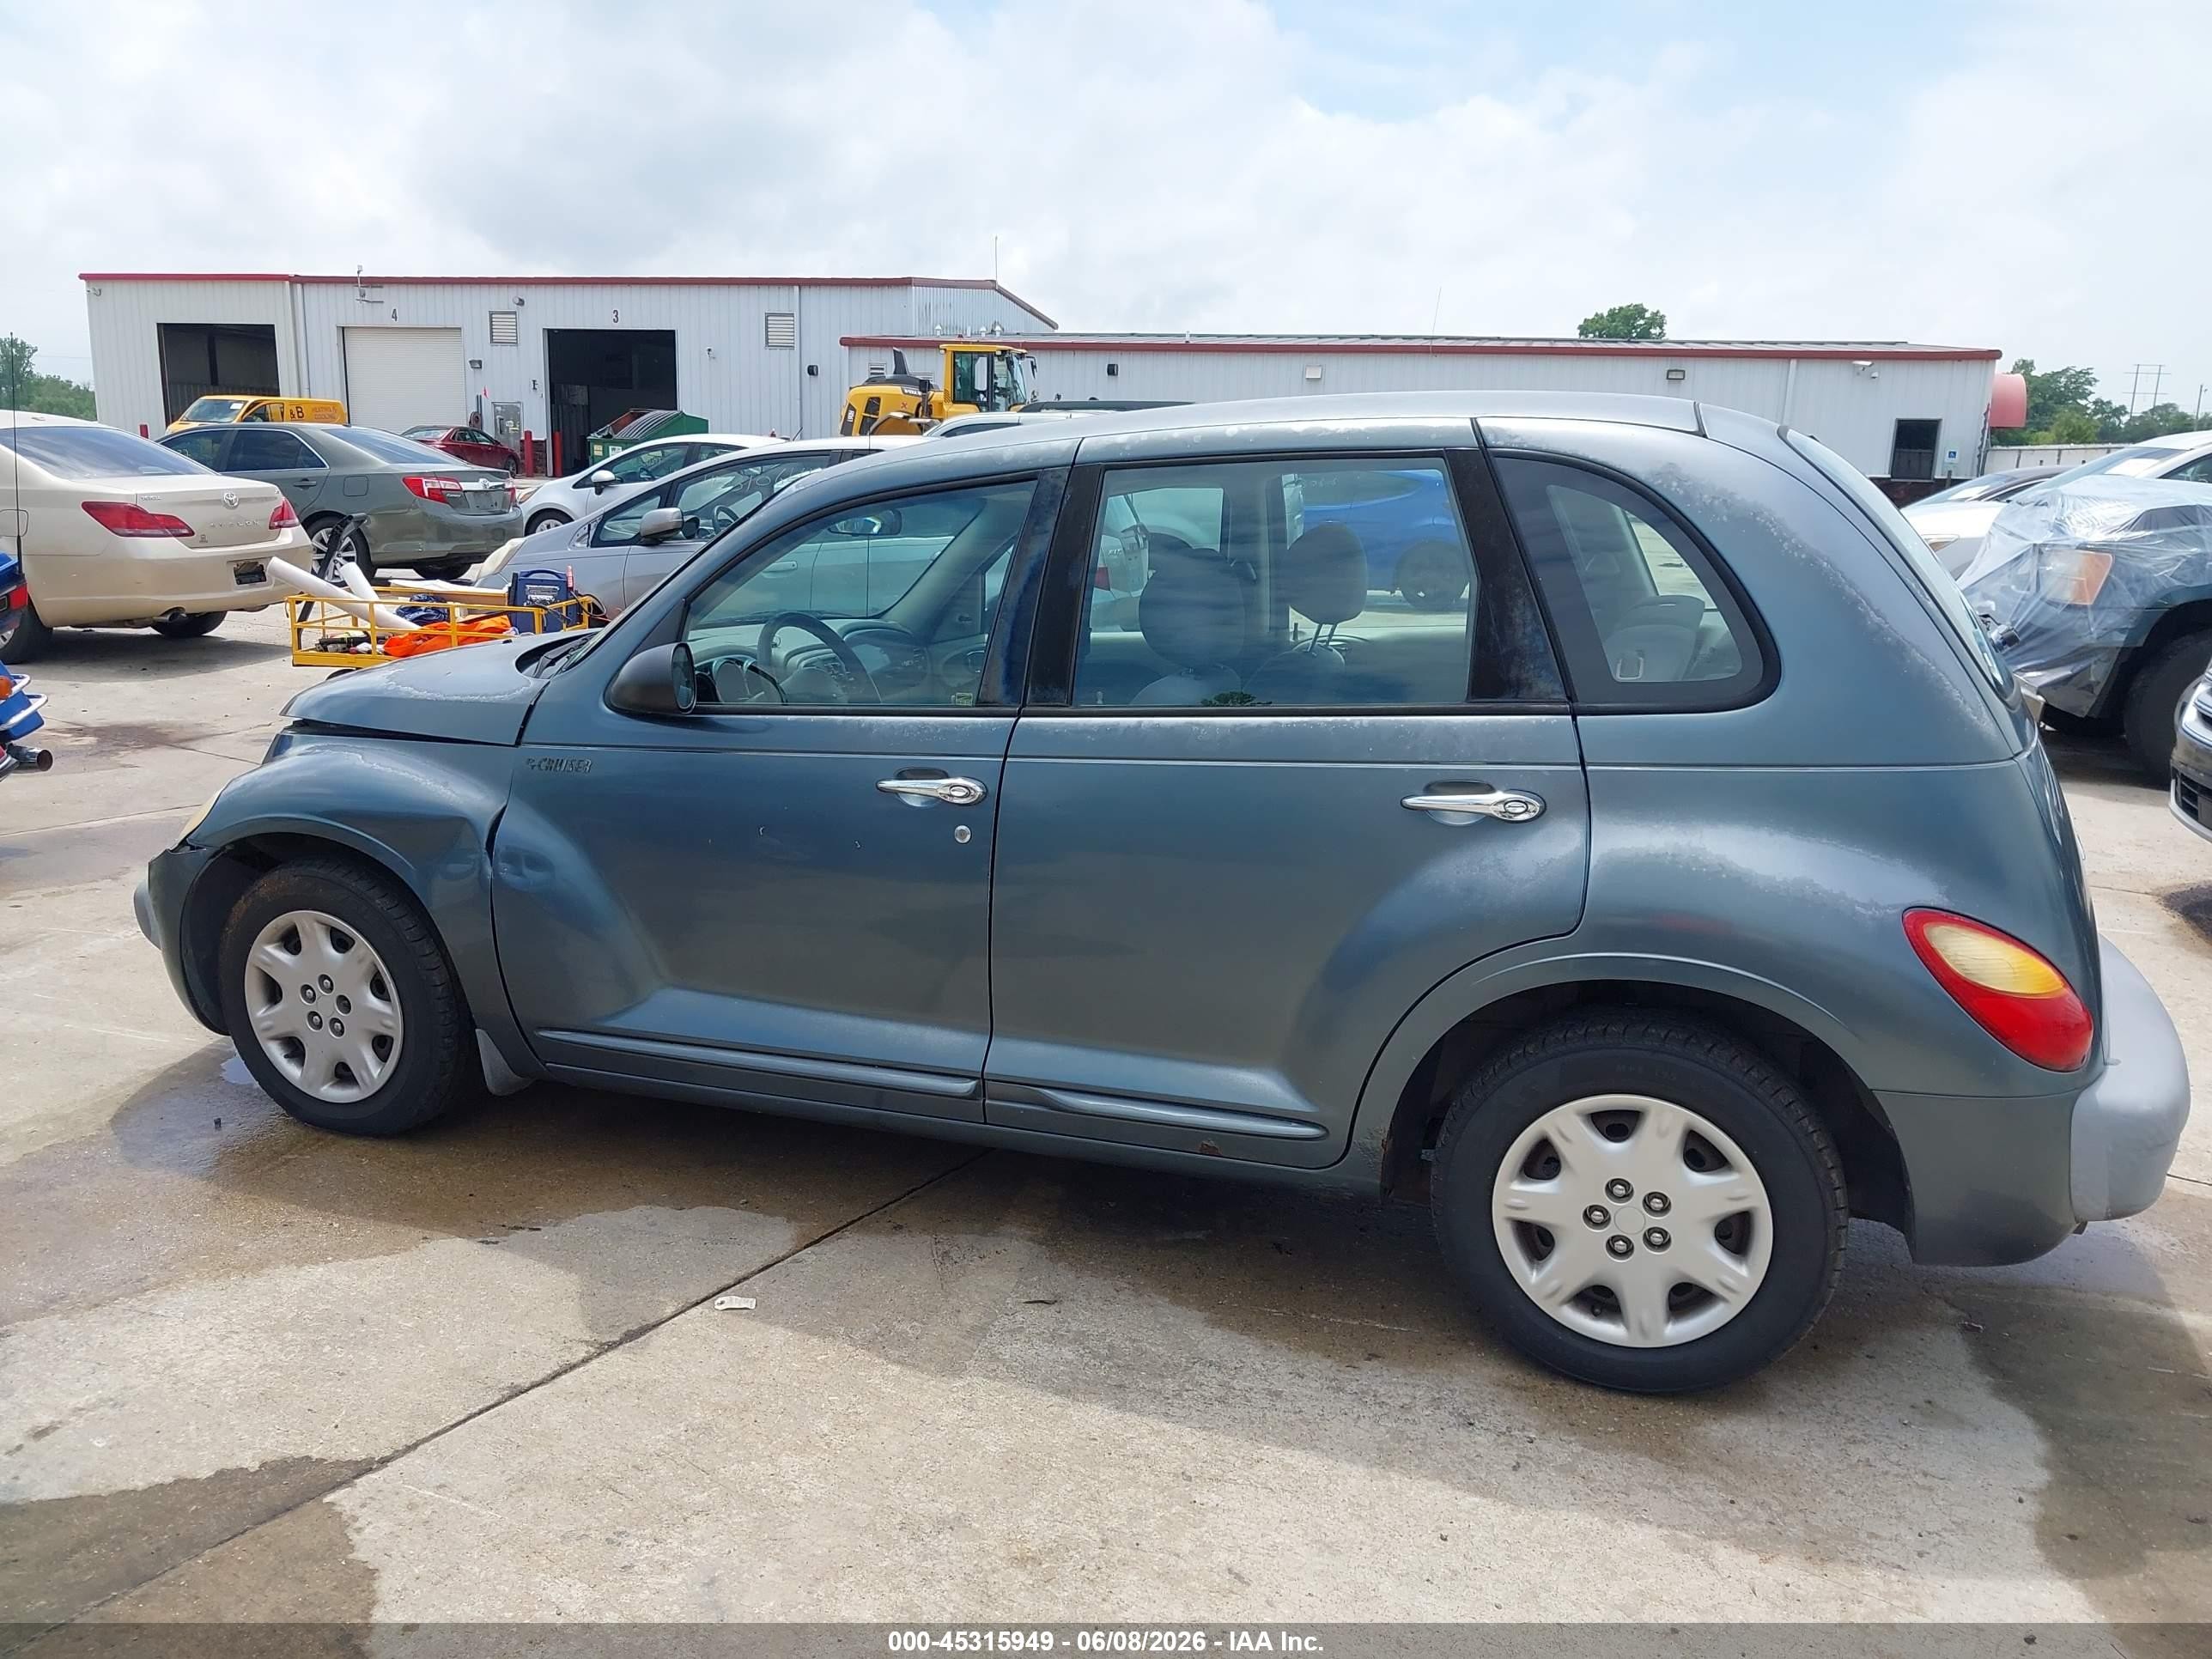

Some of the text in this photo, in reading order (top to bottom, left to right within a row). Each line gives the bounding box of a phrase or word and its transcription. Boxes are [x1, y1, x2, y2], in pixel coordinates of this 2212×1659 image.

[392, 309, 398, 322] 4
[612, 309, 619, 323] 3
[289, 406, 304, 419] & B
